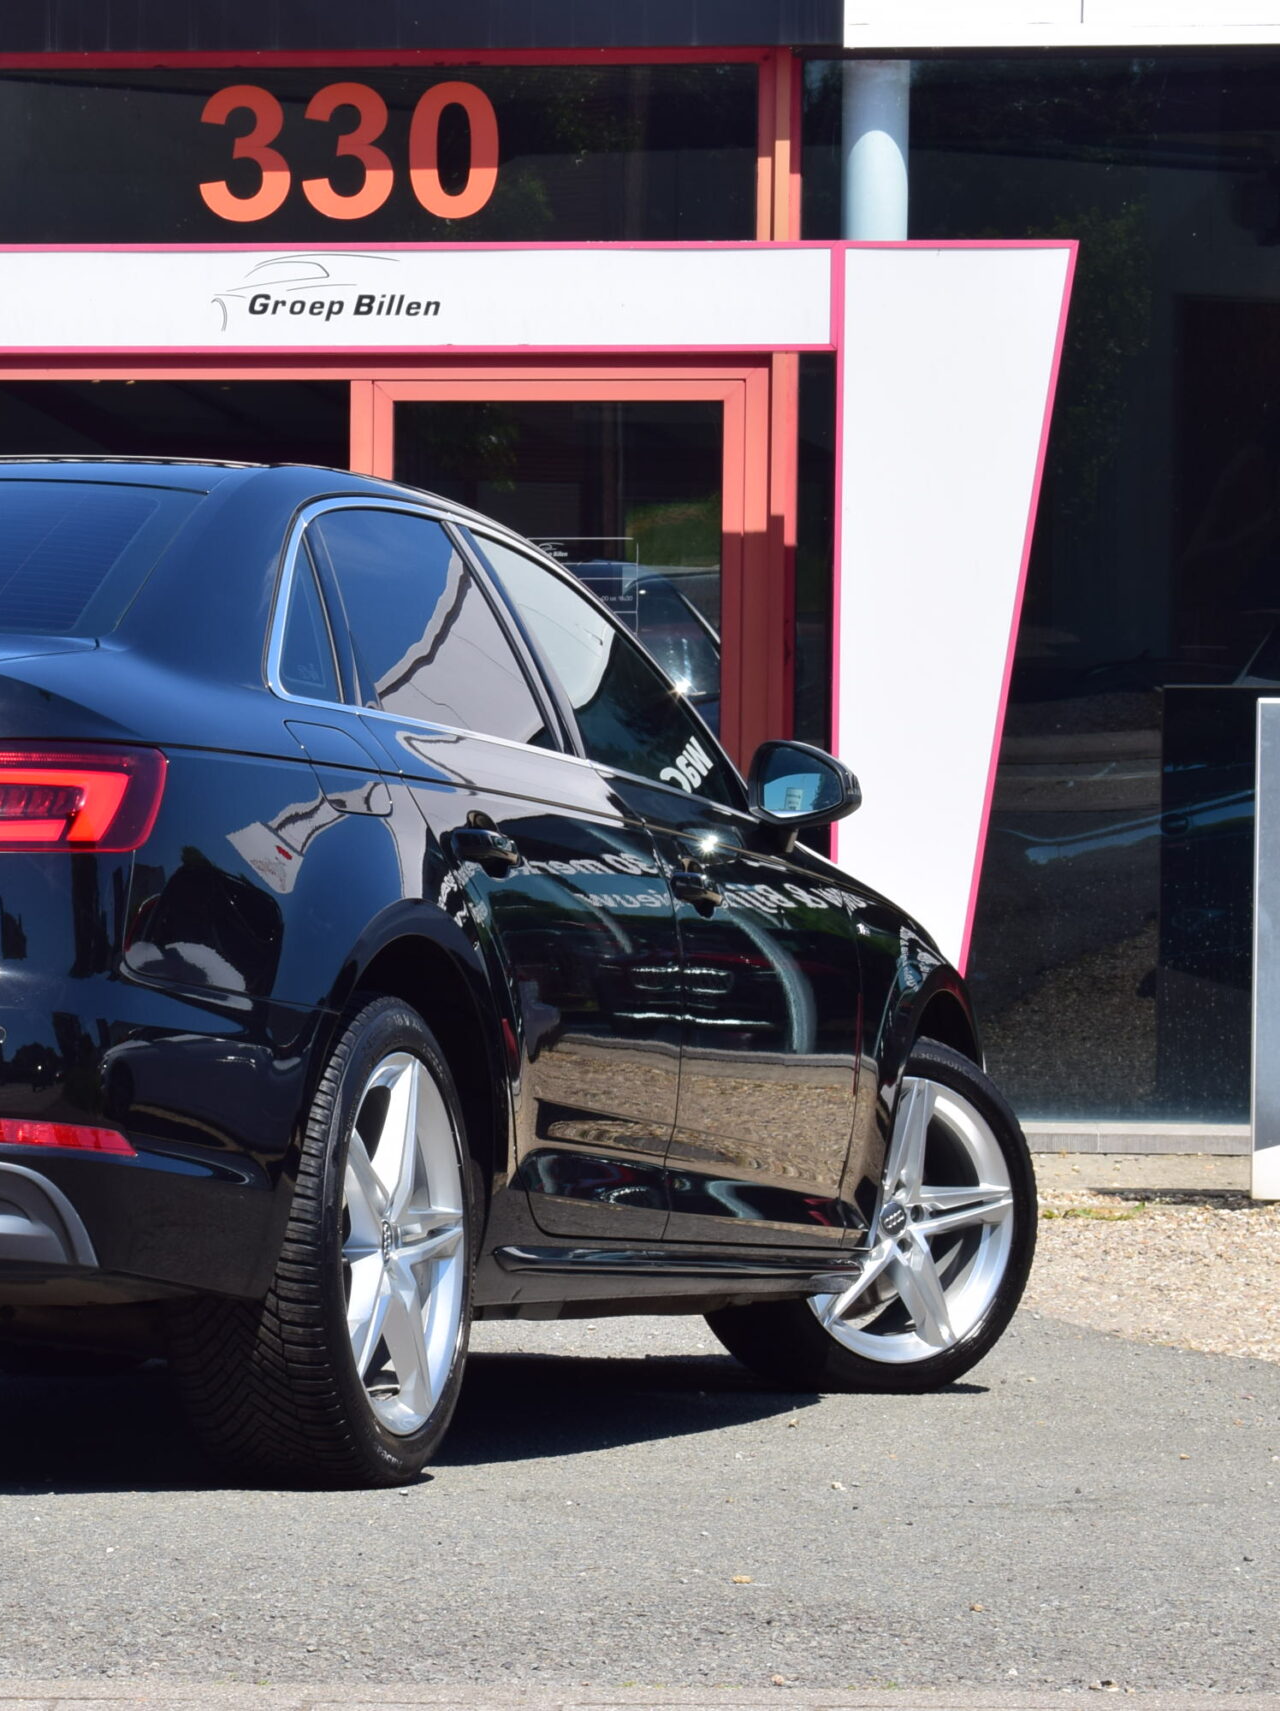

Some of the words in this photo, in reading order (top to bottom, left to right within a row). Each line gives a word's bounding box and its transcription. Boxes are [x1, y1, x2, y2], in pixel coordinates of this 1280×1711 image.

[200, 82, 499, 222] 330
[248, 293, 344, 321] Groep
[353, 293, 441, 316] Billen
